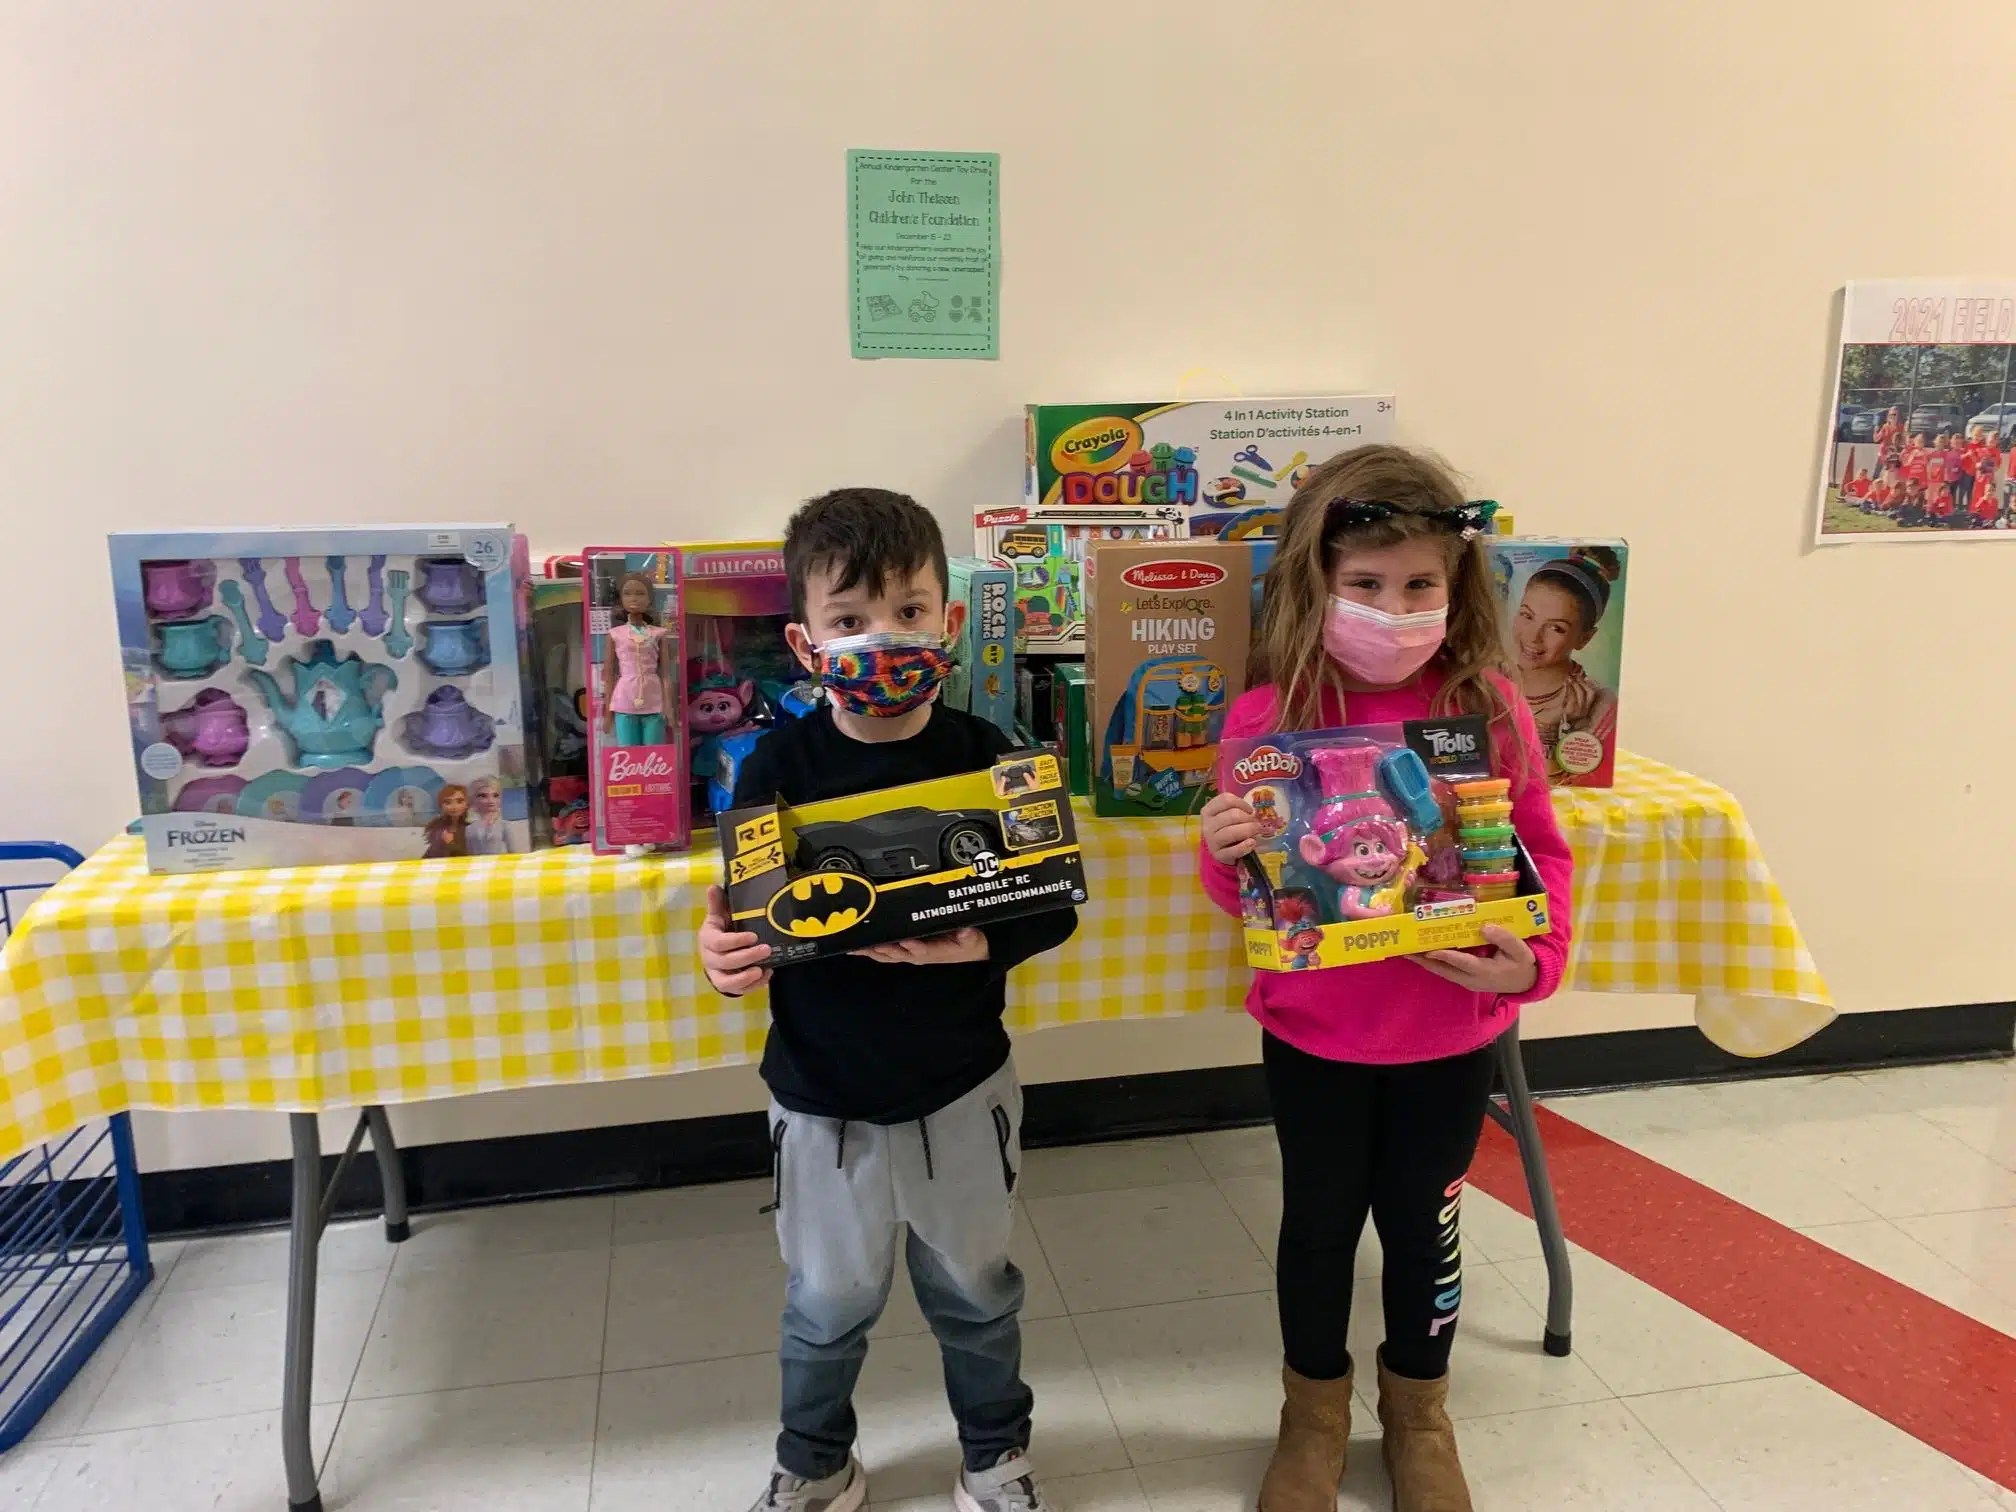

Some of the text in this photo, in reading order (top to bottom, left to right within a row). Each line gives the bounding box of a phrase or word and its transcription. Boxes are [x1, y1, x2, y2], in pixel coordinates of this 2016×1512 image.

[888, 189, 915, 203] John
[921, 212, 980, 227] Foundation
[1888, 296, 2014, 343] 2021 FIELD
[1224, 406, 1349, 422] 4 In 1 Activity Station
[1376, 401, 1393, 413] 3+
[1063, 427, 1126, 455] Crayola
[1209, 424, 1362, 440] Station D'activités 4-en-1
[1062, 467, 1199, 505] DOUGH
[983, 513, 1020, 525] Puzzle
[472, 541, 494, 554] 26
[1131, 568, 1178, 585] Melissa
[1189, 568, 1217, 585] Doug
[991, 582, 1007, 639] ROCK
[1136, 593, 1161, 611] Let's
[982, 583, 992, 640] PAINTING
[1130, 617, 1216, 641] HIKING
[990, 645, 1000, 664] KIT
[1147, 643, 1198, 655] PLAY SET
[1422, 728, 1476, 757] Trolls
[608, 750, 673, 782] Barbie
[167, 827, 247, 848] FROZEN
[972, 855, 1000, 875] DC
[1064, 856, 1078, 865] 4+
[1016, 874, 1031, 885] RC
[977, 879, 1073, 908] RADIOCOMMANDÉE
[1416, 906, 1424, 919] 6
[1343, 928, 1400, 952] POPPY
